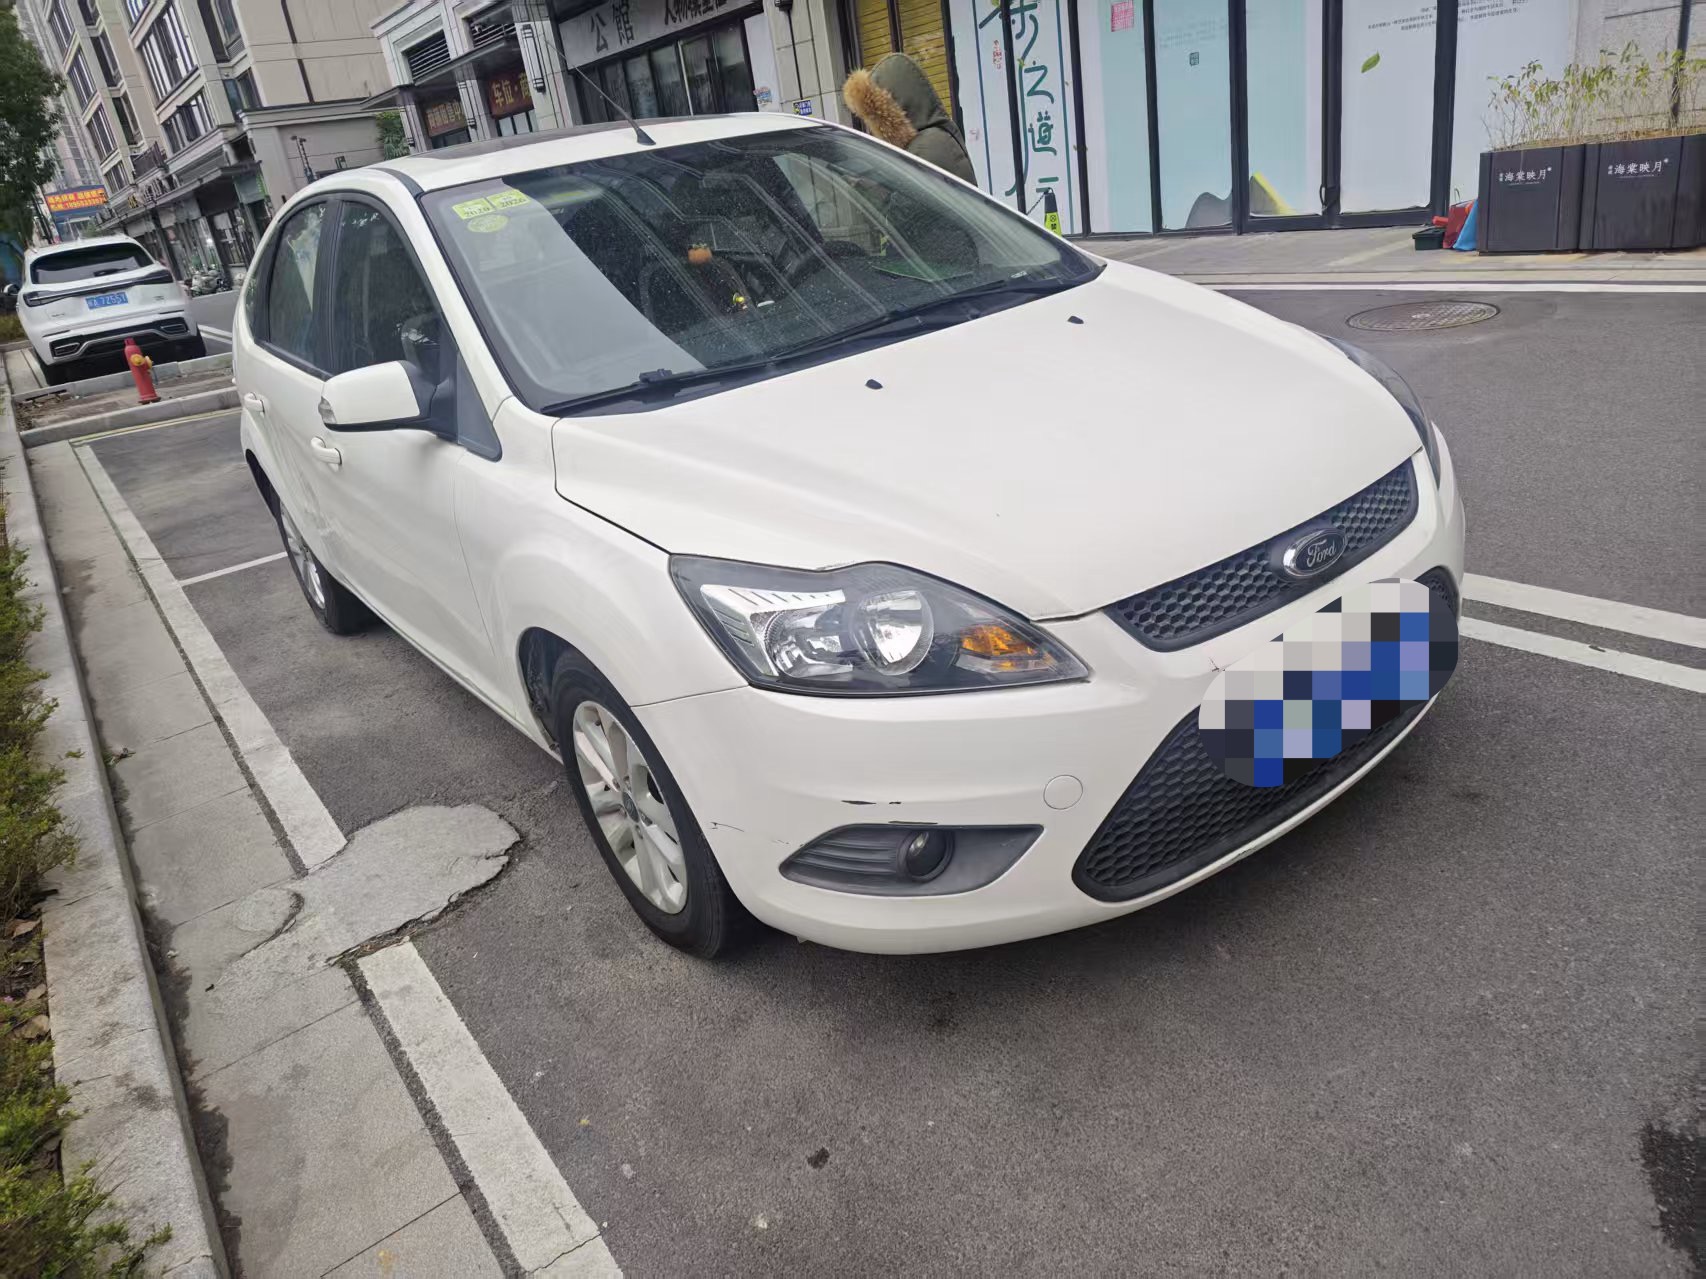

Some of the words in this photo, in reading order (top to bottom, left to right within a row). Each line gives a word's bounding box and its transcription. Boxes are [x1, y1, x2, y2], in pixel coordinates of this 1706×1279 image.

[1614, 161, 1662, 174] 海棠映月
[1504, 169, 1546, 183] 海棠映月
[1306, 539, 1337, 568] Ford
